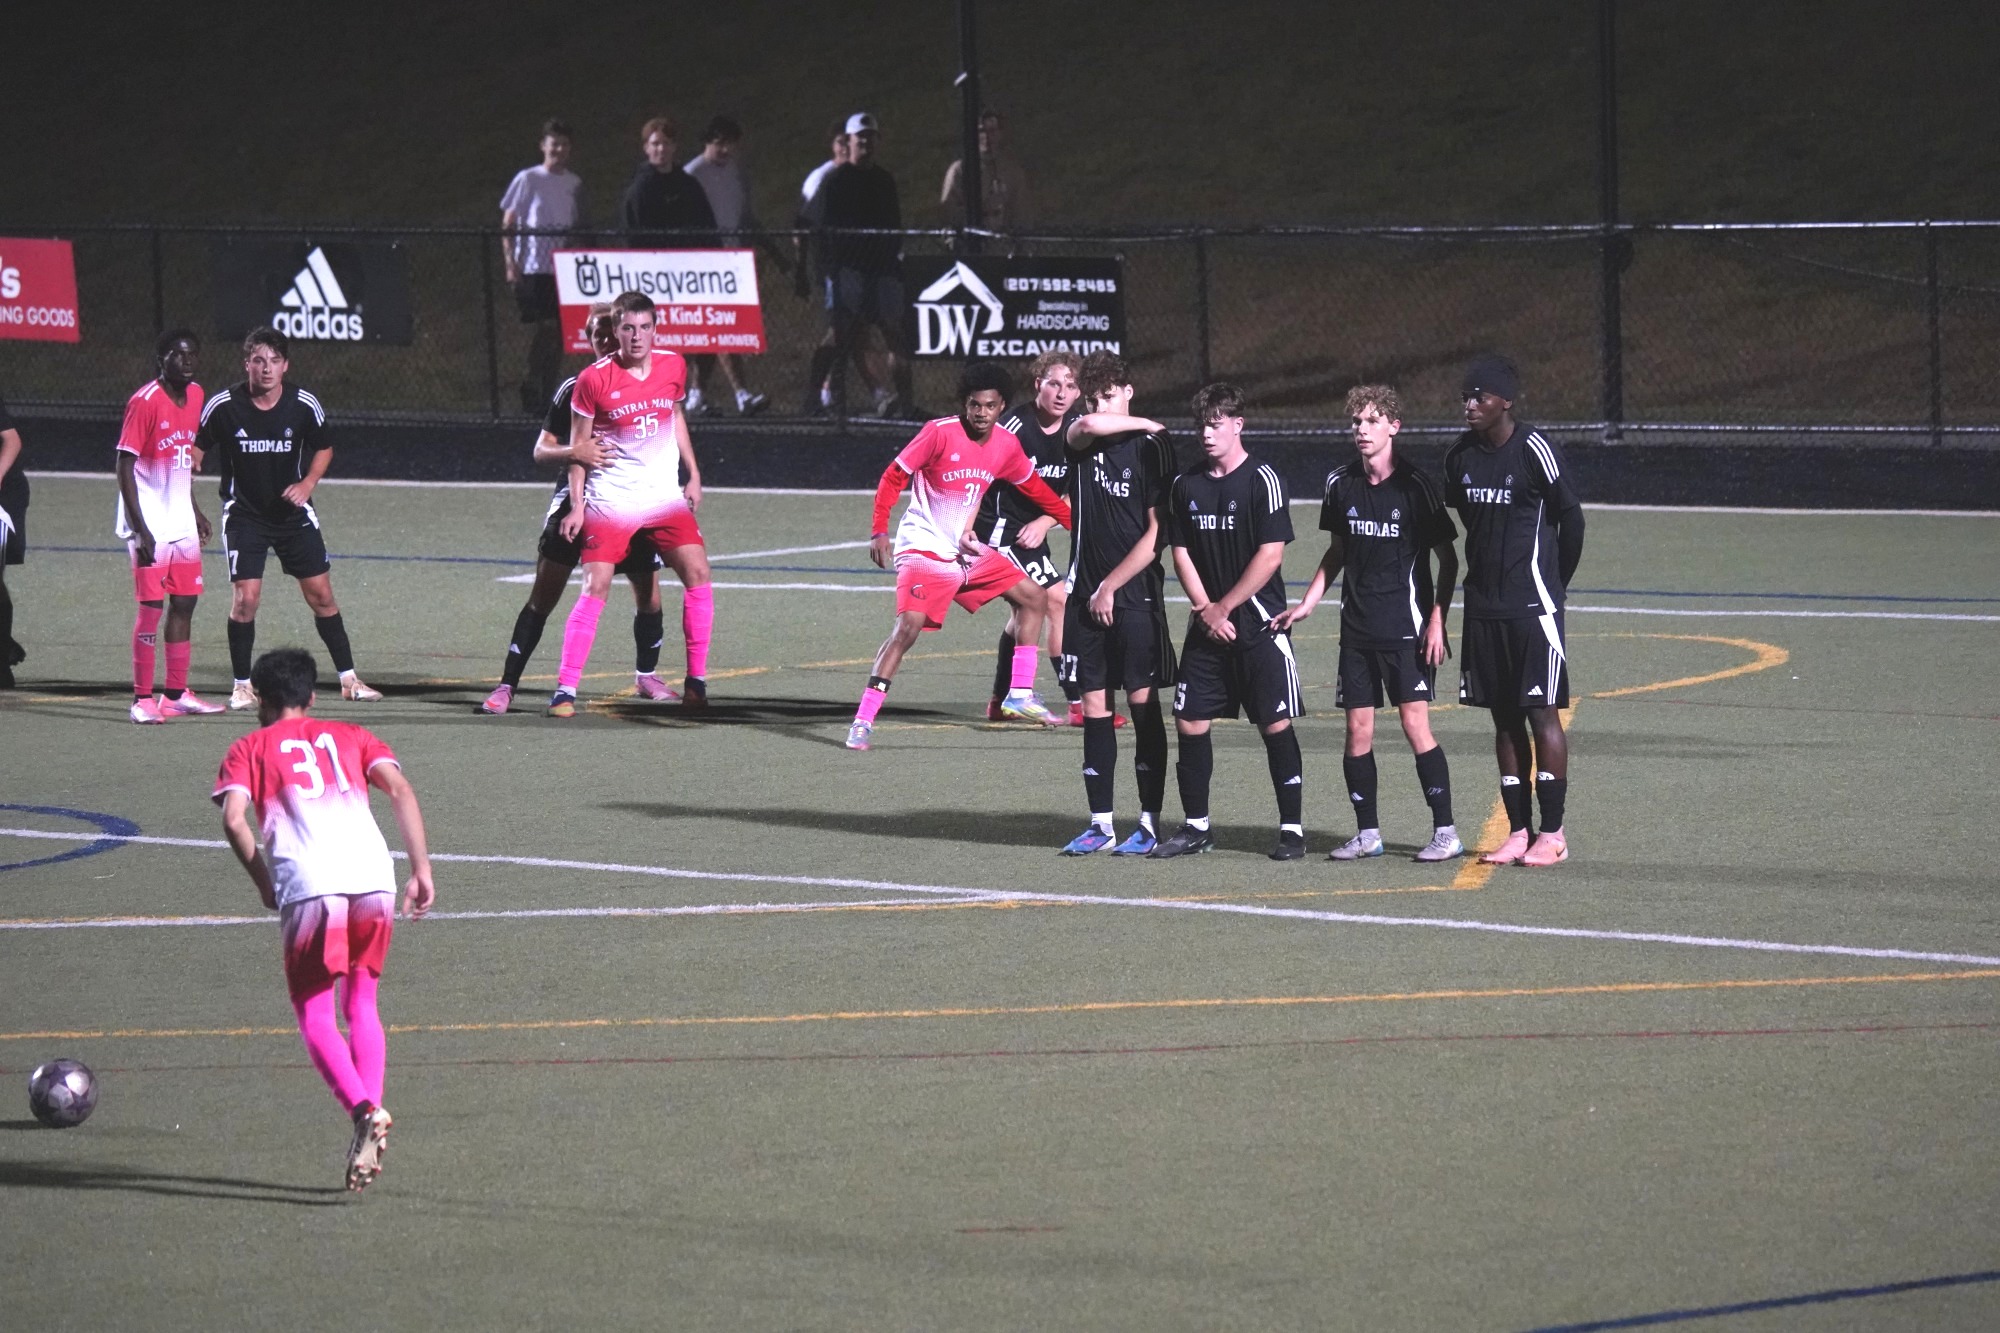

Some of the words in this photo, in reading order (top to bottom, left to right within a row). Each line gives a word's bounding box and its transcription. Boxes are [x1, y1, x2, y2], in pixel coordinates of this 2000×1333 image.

[606, 264, 738, 301] Husqvarna
[27, 306, 75, 328] GOODS
[272, 304, 364, 341] adidas
[669, 307, 704, 325] Kind
[705, 307, 737, 325] Saw
[1016, 314, 1110, 331] HARDSCAPING
[913, 303, 981, 356] DW
[608, 401, 649, 421] CENTRAL
[632, 412, 659, 440] 35
[172, 444, 192, 470] 36
[240, 440, 292, 453] THOMAS
[942, 468, 980, 482] CENTRAL
[963, 483, 981, 507] 31
[228, 550, 239, 575] 7
[1025, 555, 1059, 586] 24
[280, 732, 350, 799] 31
